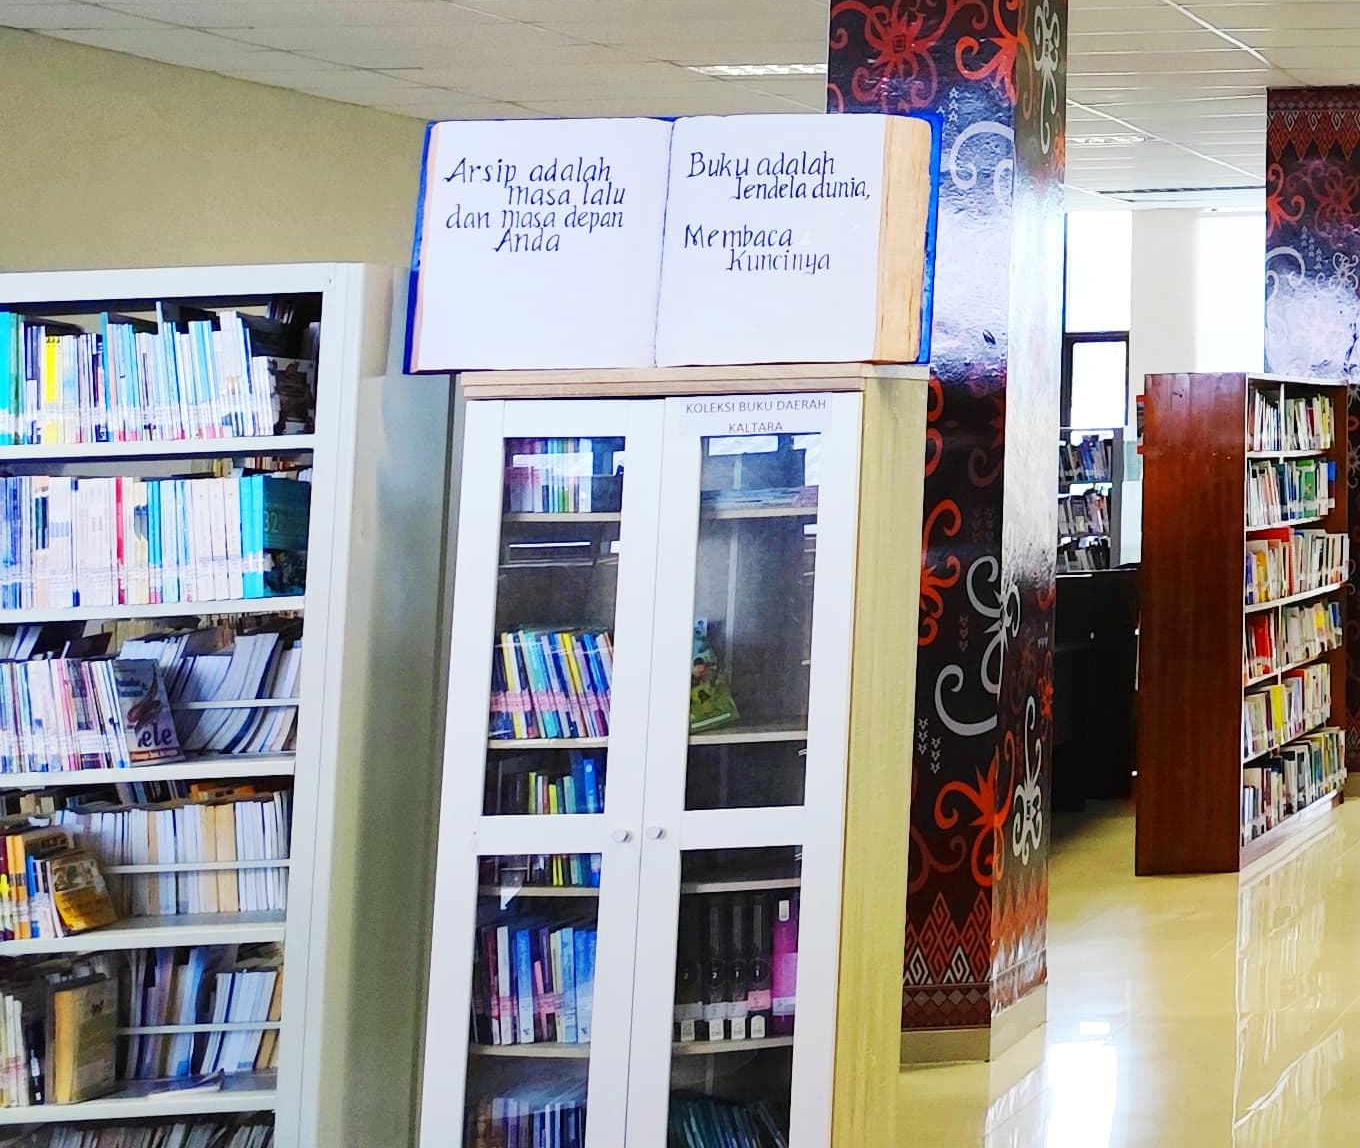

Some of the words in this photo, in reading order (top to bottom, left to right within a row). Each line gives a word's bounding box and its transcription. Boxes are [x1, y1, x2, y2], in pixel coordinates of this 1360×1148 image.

[442, 157, 517, 188] Arsip
[529, 156, 611, 182] adalah
[686, 151, 749, 178] Buku
[756, 151, 834, 175] adalah
[508, 185, 571, 205] masa
[583, 181, 626, 205] lalu
[728, 175, 807, 200] Jendela
[446, 204, 490, 228] dan
[501, 209, 556, 228] masa
[564, 205, 624, 233] depan
[492, 227, 561, 252] Anda
[684, 224, 793, 249] Membaca
[725, 249, 830, 275] Kuncinya
[686, 403, 735, 413] KOLEKSI
[739, 401, 773, 412] BUKU
[777, 399, 826, 411] DAERAH
[729, 421, 783, 433] KALTARA
